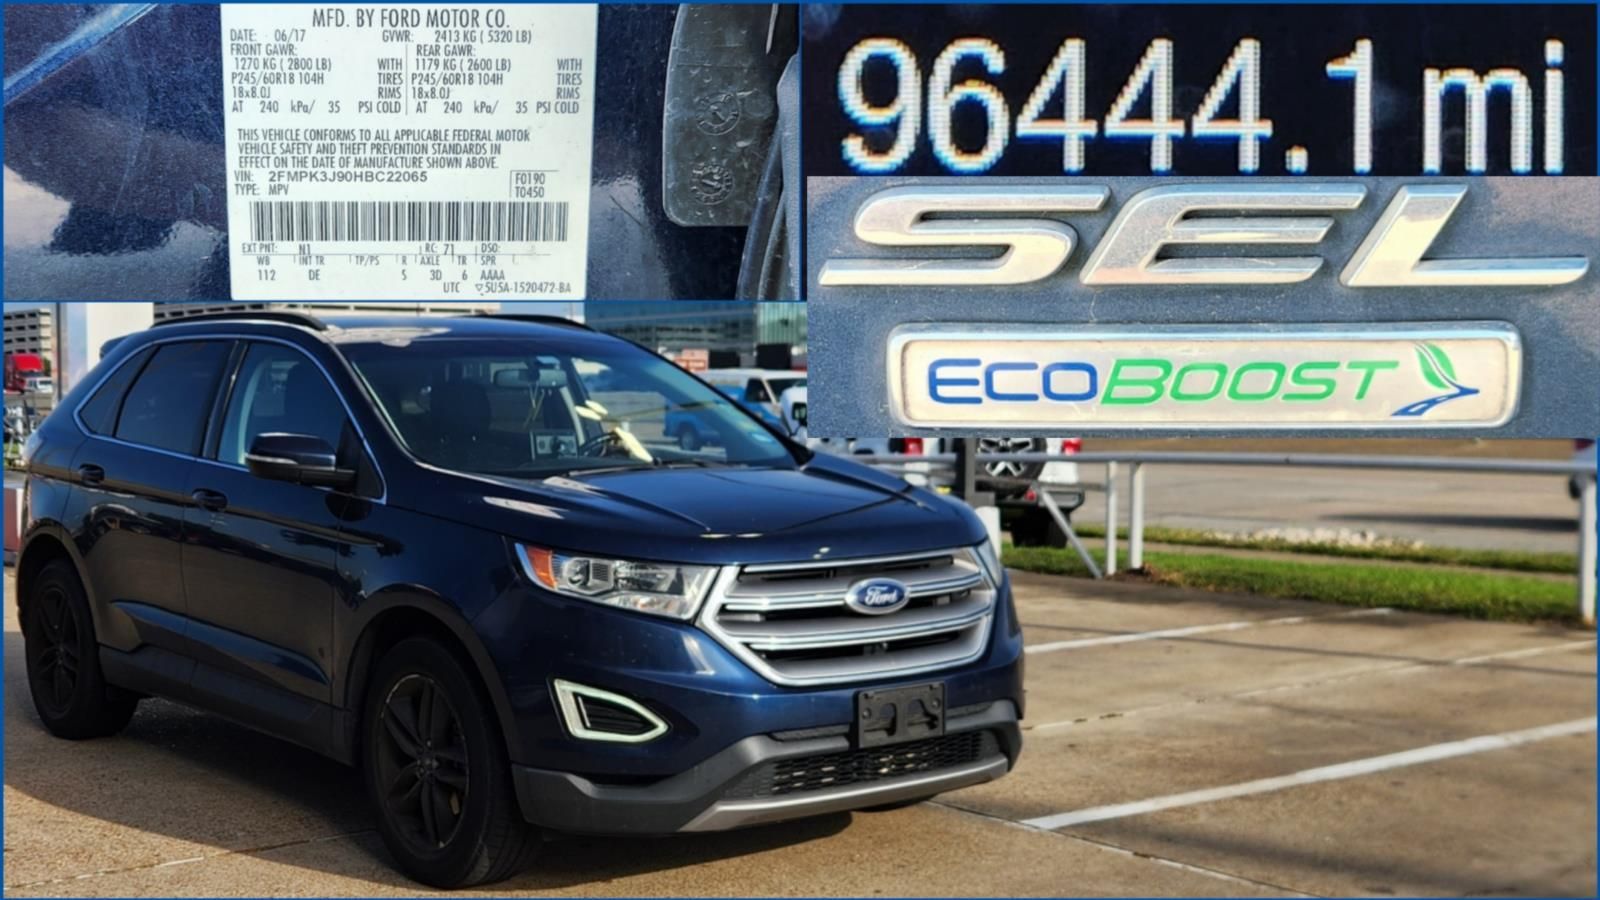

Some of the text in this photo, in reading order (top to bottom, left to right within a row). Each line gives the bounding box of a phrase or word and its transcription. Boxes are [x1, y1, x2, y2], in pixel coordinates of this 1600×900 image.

[312, 8, 510, 28] MFD. BY FORD MOTOR CO.
[230, 29, 305, 42] DATE: 06/17
[383, 30, 413, 42] GVWR:
[435, 30, 460, 42] 2413
[463, 30, 476, 42] KG
[488, 30, 512, 42] 5320
[516, 30, 532, 43] LB)
[231, 43, 297, 56] FRONT GAWR:
[416, 44, 476, 57] REAR GAWR:
[235, 58, 259, 70] 1270
[263, 58, 276, 70] KG
[288, 58, 312, 70] 2800
[316, 58, 331, 71] LB)
[378, 58, 402, 70] WITH
[416, 58, 439, 70] 1179
[443, 58, 456, 70] KG
[468, 58, 492, 70] 2600
[496, 58, 511, 72] LB)
[557, 58, 582, 70] WITH
[232, 72, 324, 85] P245/60R18 104H
[378, 72, 403, 85] TIRES
[412, 73, 503, 86] P245/60R18 104H
[557, 73, 582, 85] TIRES
[233, 86, 271, 99] 18x8.0J
[378, 87, 401, 99] RIMS
[412, 87, 450, 99] 18x8.0J
[557, 87, 580, 99] RIMS
[232, 100, 401, 114] AT 240 kPa/ 35 PSI COLD
[416, 100, 579, 114] AT 240 kPa/ 35 PSI COLD
[838, 38, 1564, 175] 96444.1 mi
[238, 129, 530, 141] THIS VEHICLE CONFORMS TO ALL APPLICABLE FEDERAL MOTOR
[238, 143, 501, 155] VEHICLE SAFETY AND THEFT PREVENTION STANDARDS IN
[239, 156, 499, 168] EFFECT ON THE DATE OF MANUFACTURE SHOWN ABOVE.
[234, 170, 427, 182] VIN: 2FMPK3J90HBC22065
[515, 173, 545, 184] F0190
[235, 184, 289, 195] TYPE: MPV
[515, 187, 545, 198] T0450
[819, 183, 1589, 286] SEL
[242, 243, 256, 253] EXT
[259, 243, 278, 253] PNT:
[257, 256, 270, 265] WB
[299, 256, 324, 265] INT TR
[356, 256, 379, 266] TP/PS
[420, 256, 439, 265] AXLE
[458, 256, 466, 265] TR
[481, 256, 496, 265] SPR
[258, 269, 276, 280] 112
[309, 269, 320, 280] DE
[480, 270, 505, 280] AAAA
[443, 283, 460, 292] UTC
[865, 586, 897, 605] Ford
